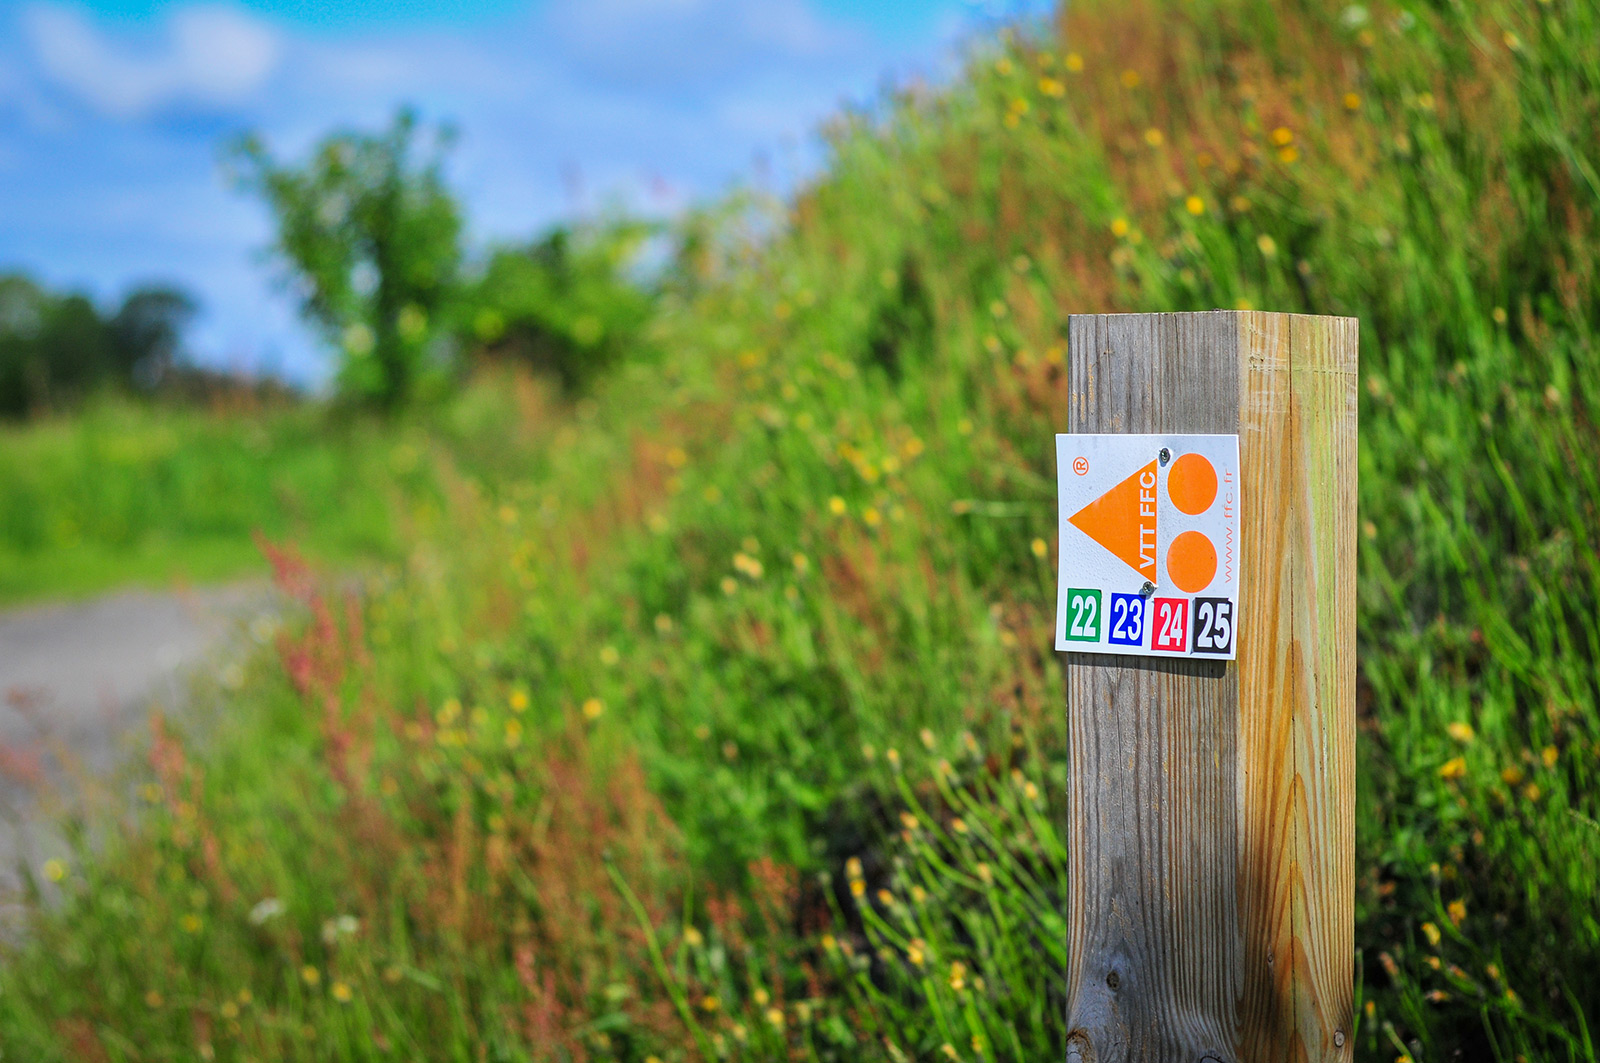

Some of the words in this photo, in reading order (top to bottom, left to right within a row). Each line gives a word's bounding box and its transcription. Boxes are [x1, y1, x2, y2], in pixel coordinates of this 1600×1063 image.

[1140, 472, 1156, 516] FFC
[1140, 524, 1155, 569] VTT
[1224, 468, 1233, 583] www.ffc.fr
[1070, 595, 1097, 637] 22
[1112, 597, 1142, 641] 23
[1158, 602, 1183, 647] 24
[1197, 602, 1230, 649] 25
